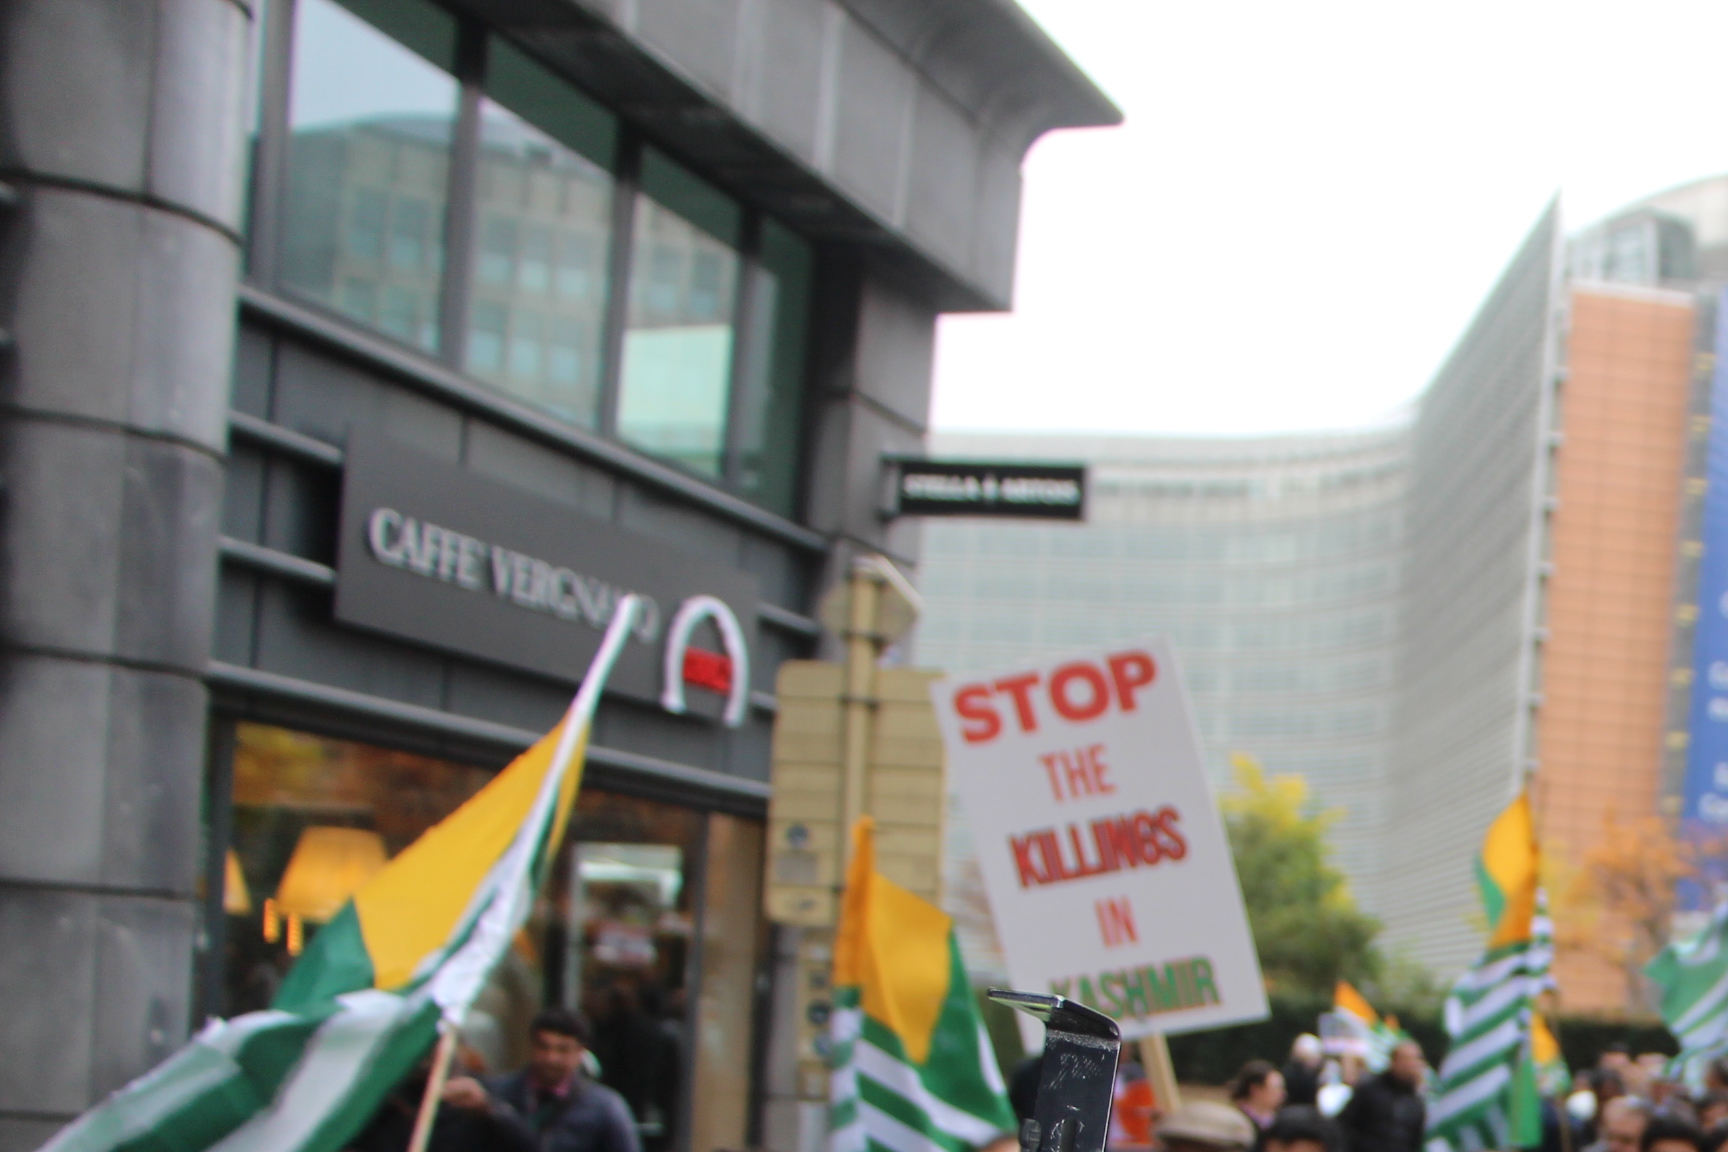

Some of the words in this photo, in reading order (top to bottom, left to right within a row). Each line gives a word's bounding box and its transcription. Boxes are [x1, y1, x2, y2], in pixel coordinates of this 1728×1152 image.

[953, 649, 1157, 744] STOP
[1039, 744, 1116, 803] THE
[1009, 806, 1187, 889] KILLINGS
[1095, 895, 1138, 947] IN
